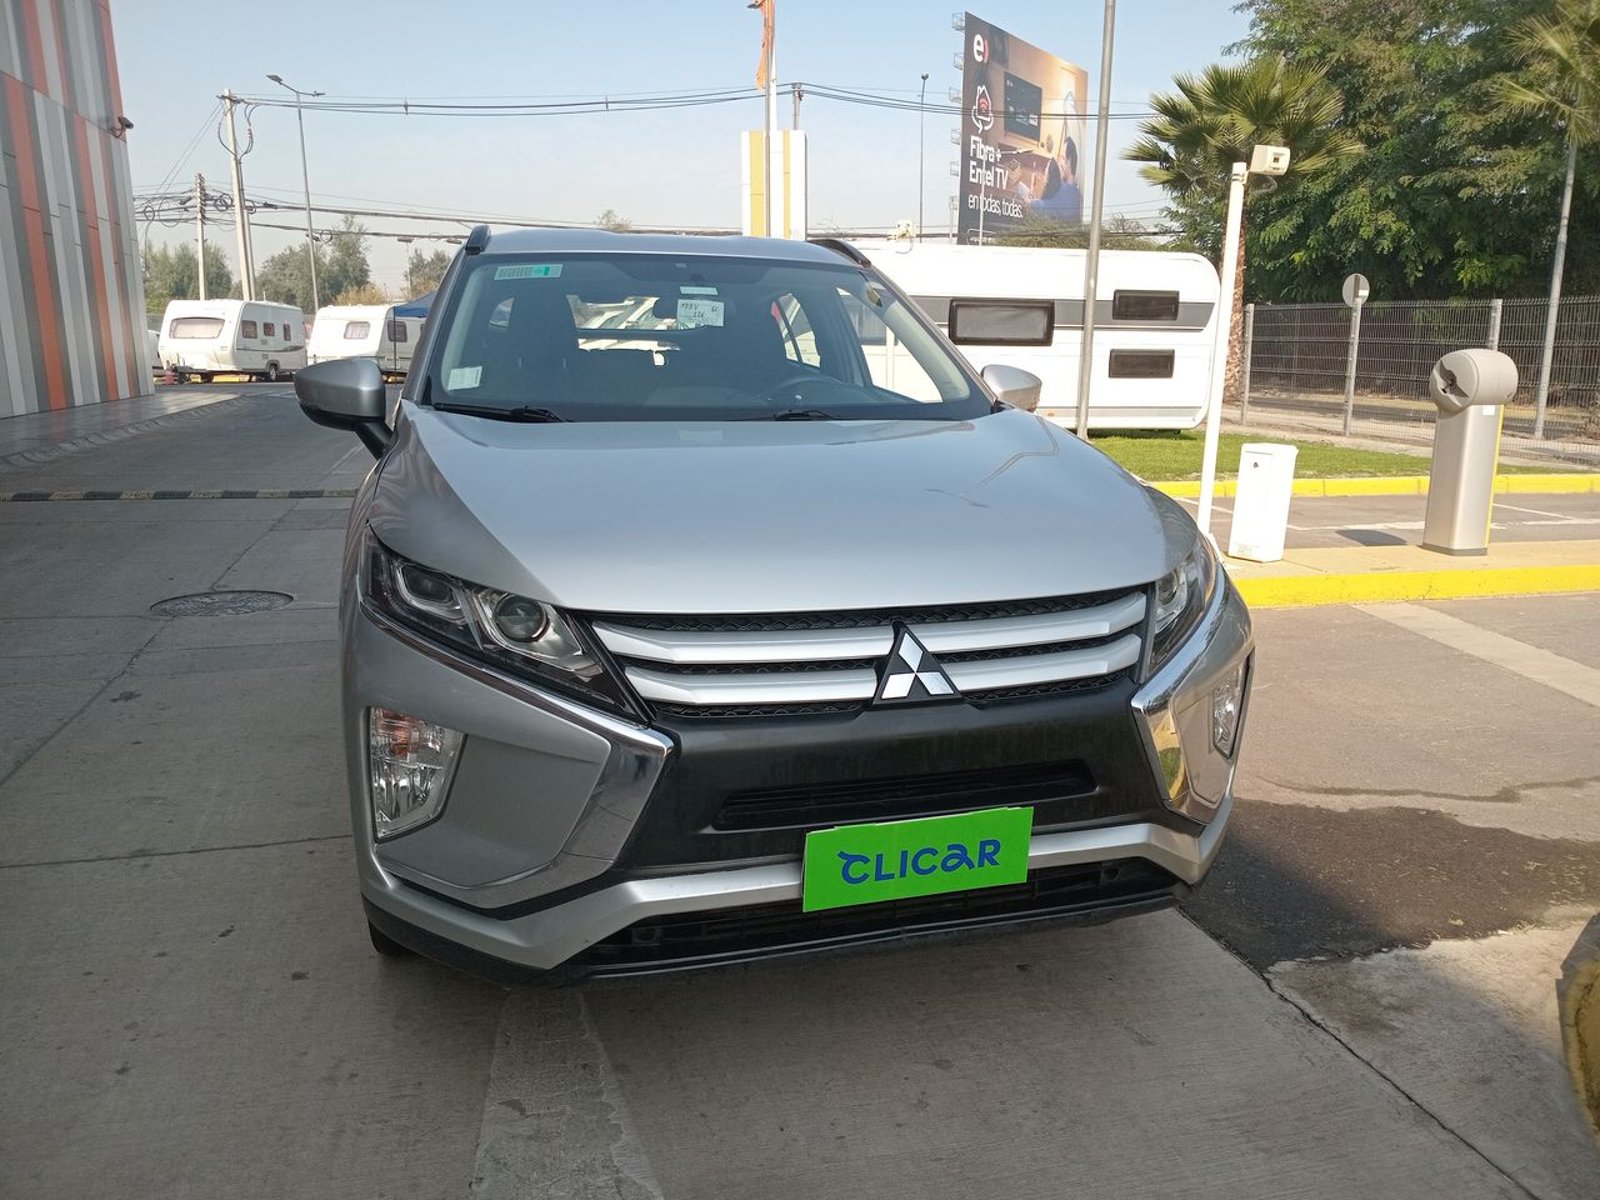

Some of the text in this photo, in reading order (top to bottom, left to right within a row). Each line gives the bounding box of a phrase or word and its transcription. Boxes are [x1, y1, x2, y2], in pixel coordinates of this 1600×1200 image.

[970, 135, 995, 163] Fibra
[995, 167, 1009, 190] TV
[968, 194, 978, 210] en
